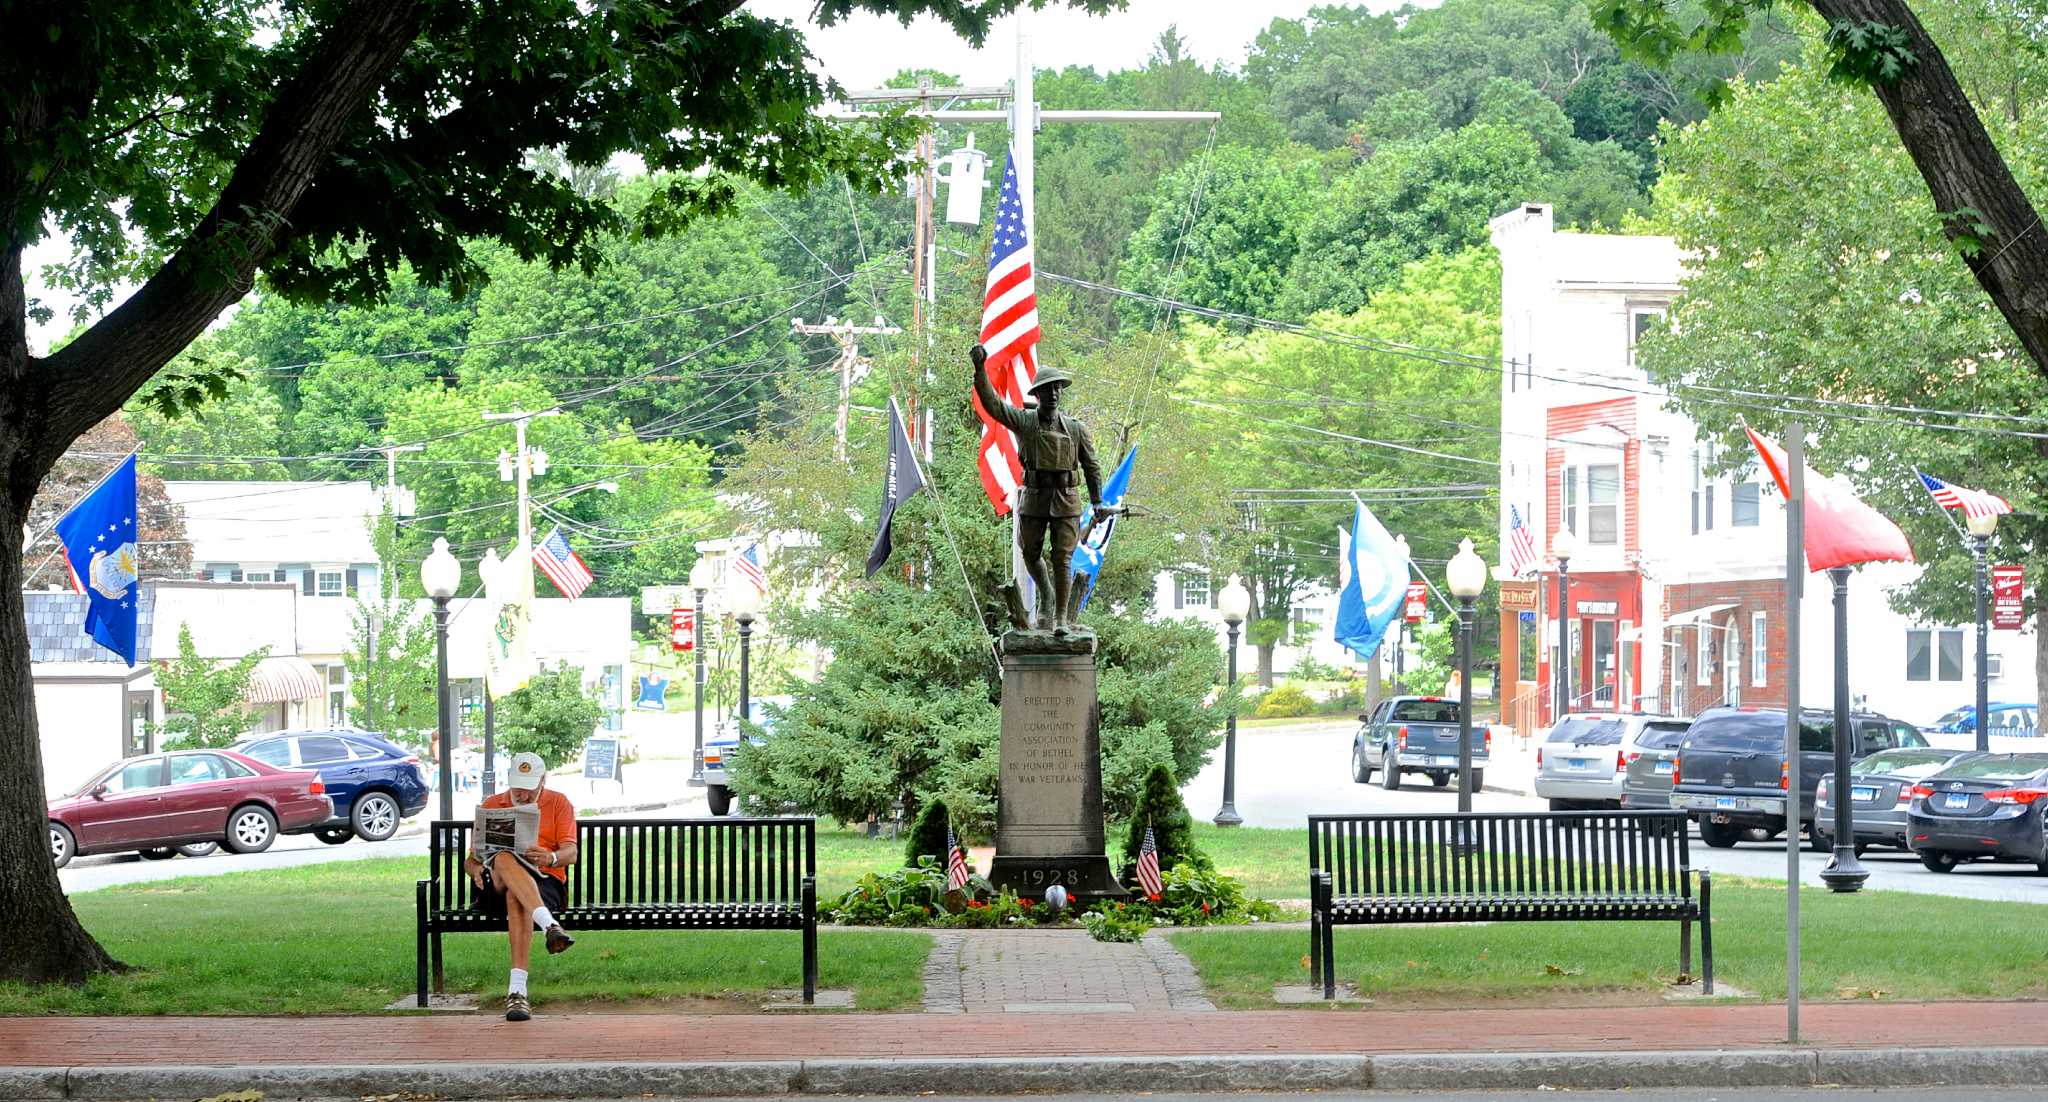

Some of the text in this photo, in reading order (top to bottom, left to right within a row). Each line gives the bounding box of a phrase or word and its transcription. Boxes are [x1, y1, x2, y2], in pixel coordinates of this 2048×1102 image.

[1024, 696, 1076, 705] ERECTED BY
[1041, 710, 1058, 719] THE
[1024, 722, 1076, 732] COMMUNITY
[1023, 735, 1079, 745] ASSOCIATION
[1026, 749, 1075, 758] OF BETHEL
[1009, 762, 1018, 770] IN
[1023, 762, 1054, 770] HONOR
[1058, 762, 1069, 770] OF
[1018, 776, 1036, 784] WAR
[1023, 869, 1079, 885] 1928
